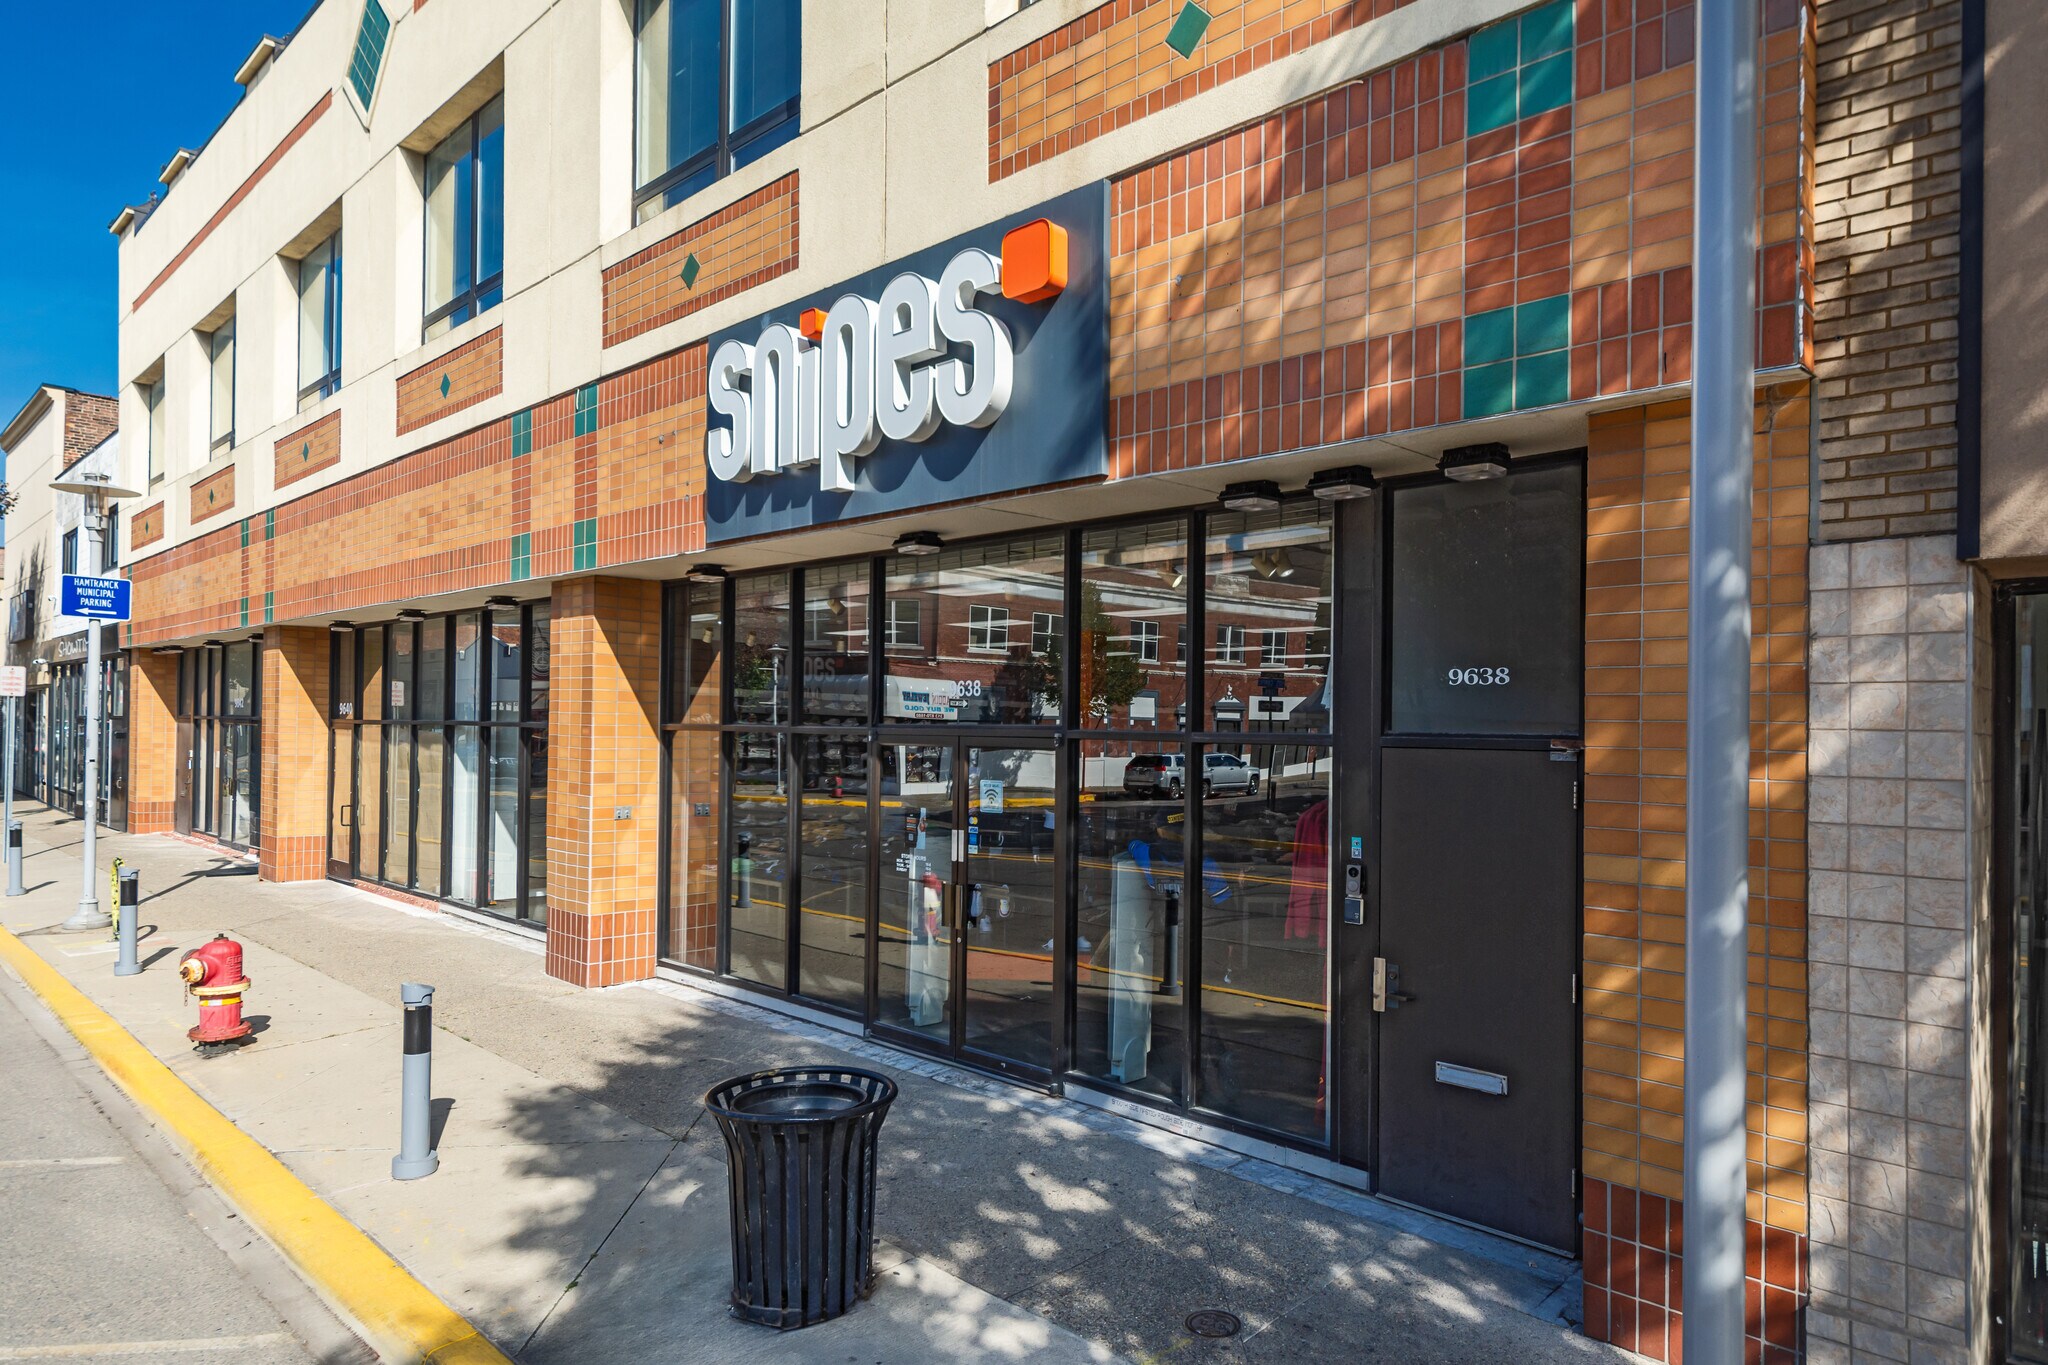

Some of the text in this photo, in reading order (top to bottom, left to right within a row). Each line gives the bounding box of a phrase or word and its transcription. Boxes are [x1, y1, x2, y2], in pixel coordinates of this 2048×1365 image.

[707, 247, 1014, 492] snipes
[74, 578, 119, 589] HAMTRAMCK
[76, 587, 116, 598] MUNICIPAL
[80, 598, 112, 607] PARKING
[1448, 667, 1510, 686] 9638
[949, 680, 981, 697] 9638
